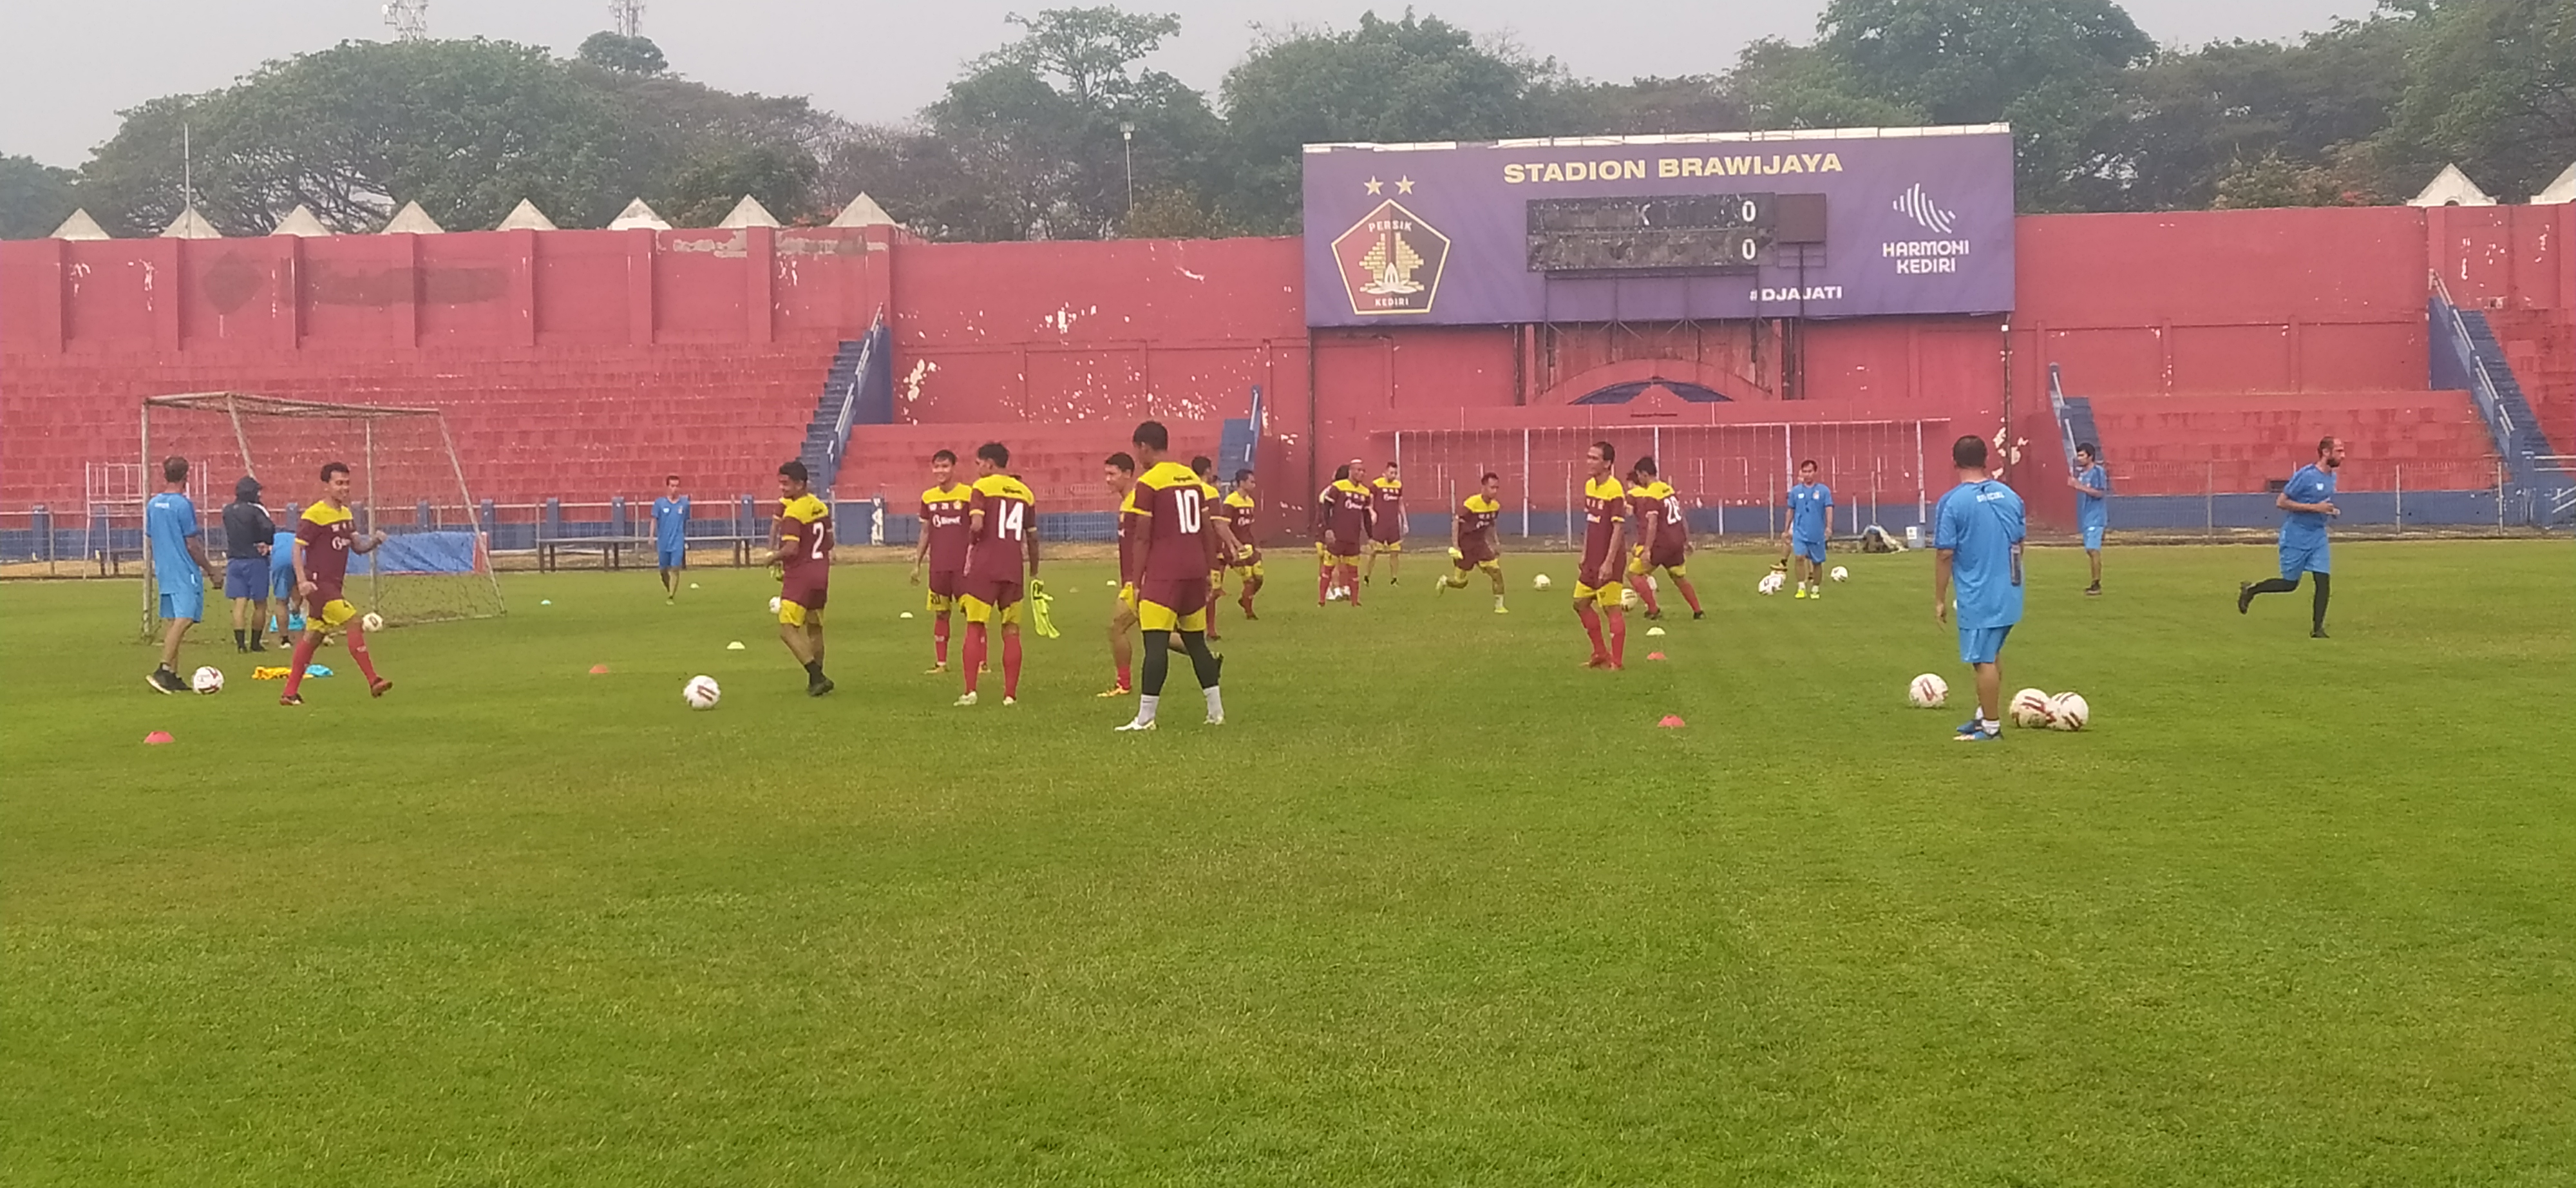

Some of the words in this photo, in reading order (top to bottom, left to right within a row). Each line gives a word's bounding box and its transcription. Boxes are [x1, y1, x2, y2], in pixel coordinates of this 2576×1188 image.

[1504, 160, 1646, 184] STADION
[1659, 153, 1842, 178] BRAWIJAYA
[1742, 200, 1756, 222] 0
[1368, 220, 1412, 233] PERSIK
[1742, 238, 1756, 260] 0
[1882, 239, 1969, 258] HARMONI
[1897, 257, 1956, 274] KEDIRI
[1375, 298, 1409, 307] KEDIRI
[998, 499, 1024, 541] 14
[1175, 489, 1200, 533] 10
[811, 522, 824, 559] 2
